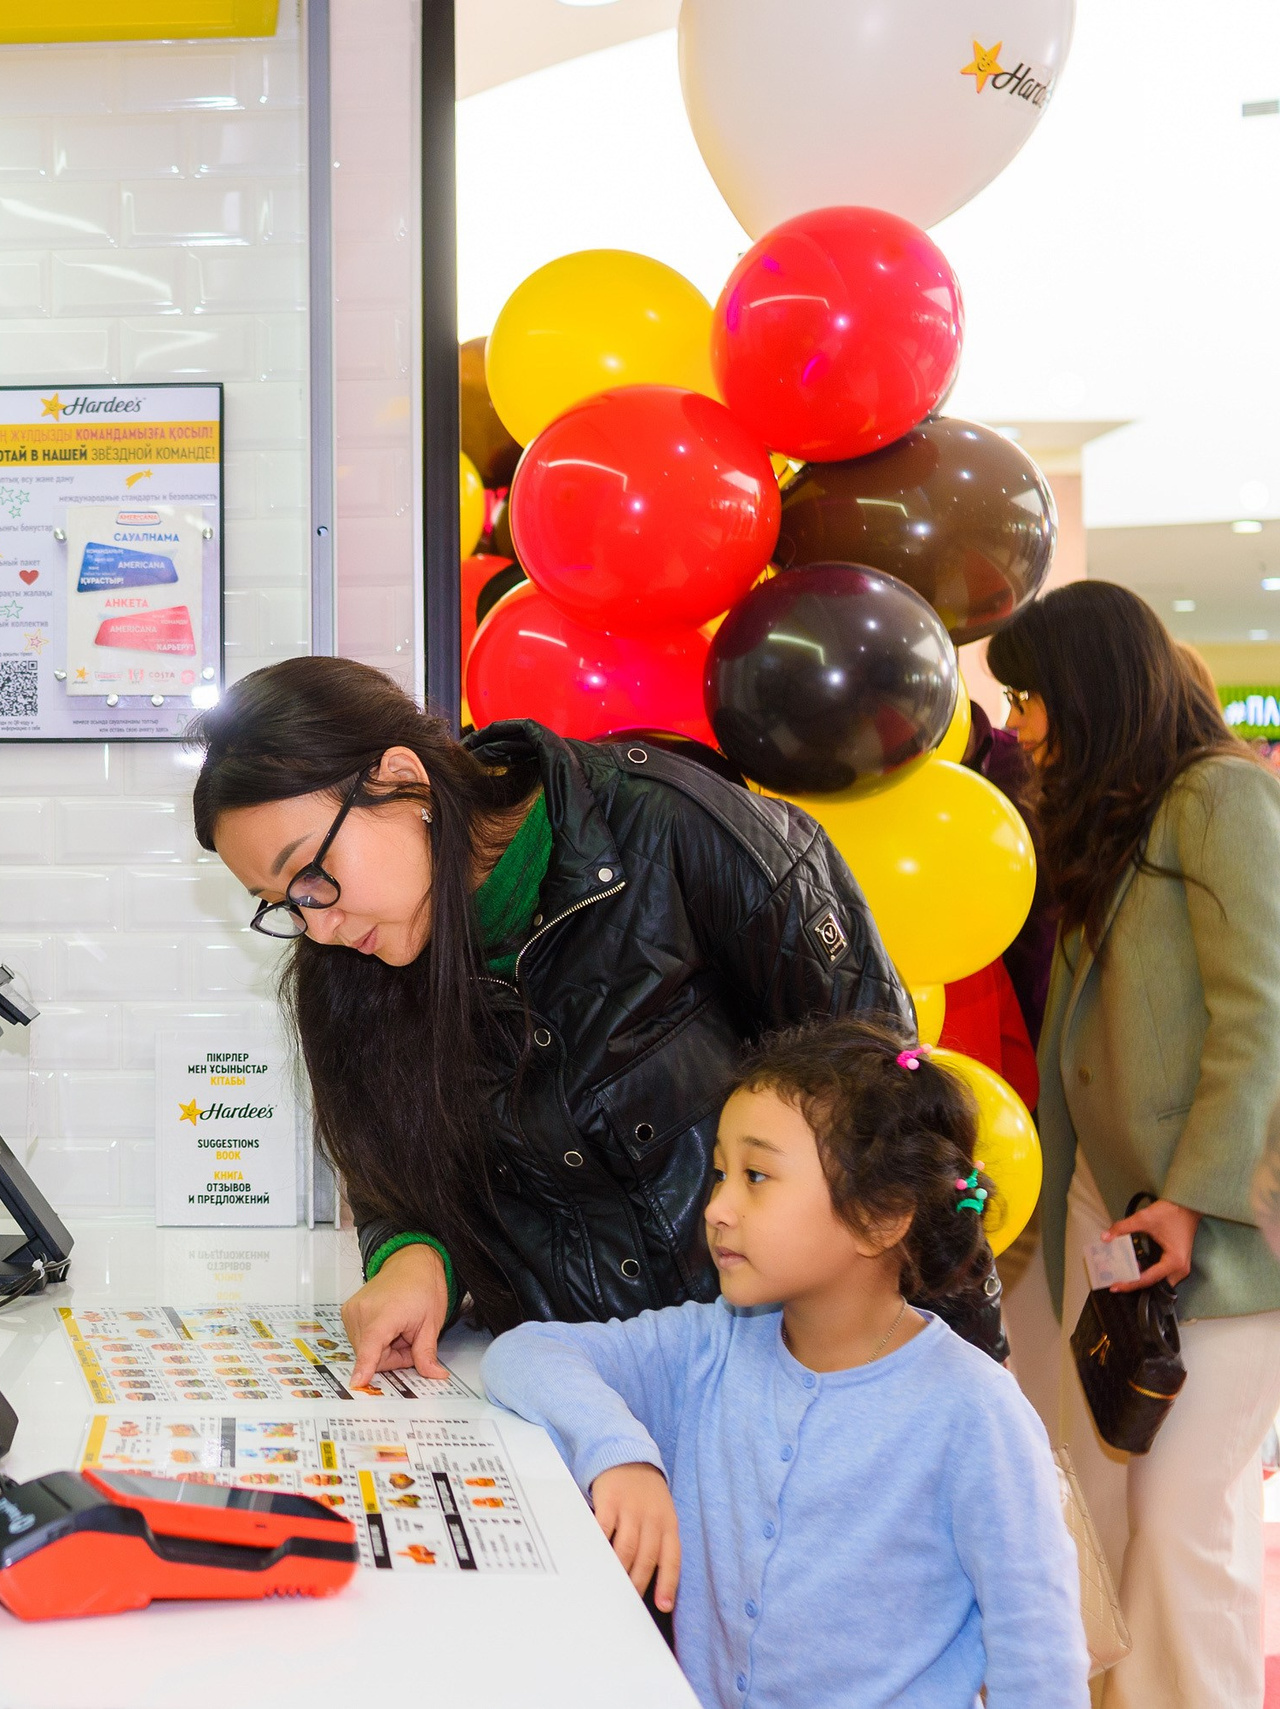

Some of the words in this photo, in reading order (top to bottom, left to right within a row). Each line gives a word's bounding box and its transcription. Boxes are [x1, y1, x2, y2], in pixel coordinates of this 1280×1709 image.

[62, 396, 142, 417] Hardee's
[75, 427, 166, 442] КОМАНДАМЫЗҒА
[169, 426, 214, 441] ҚОСЫЛ!
[30, 449, 39, 462] В
[42, 444, 88, 462] НАШЕЙ
[91, 443, 153, 463] ЗВЁЗДНОЙ
[155, 446, 216, 462] КОМАНДЕ!
[113, 532, 180, 542] САУАЛНАМА
[20, 559, 41, 567] пакет
[117, 561, 166, 570] AMERICANA
[104, 598, 149, 608] АНКЕТА
[109, 625, 158, 633] AMERICANA
[148, 672, 176, 680] COSTA
[206, 1053, 249, 1063] ПІКІРЛЕР
[188, 1064, 207, 1075] МЕН
[210, 1064, 268, 1075] ҰСЫНЫСТАР
[210, 1076, 246, 1086] КІТАБЫ
[200, 1103, 274, 1121] Hardee's
[197, 1138, 260, 1149] SUGGESTIONS
[216, 1150, 241, 1161] BOOK
[214, 1170, 244, 1181] КНИГА
[206, 1182, 251, 1193] ОТЗЫВОВ
[188, 1194, 195, 1205] И
[197, 1192, 270, 1206] ПРЕДЛОЖЕНИЙ
